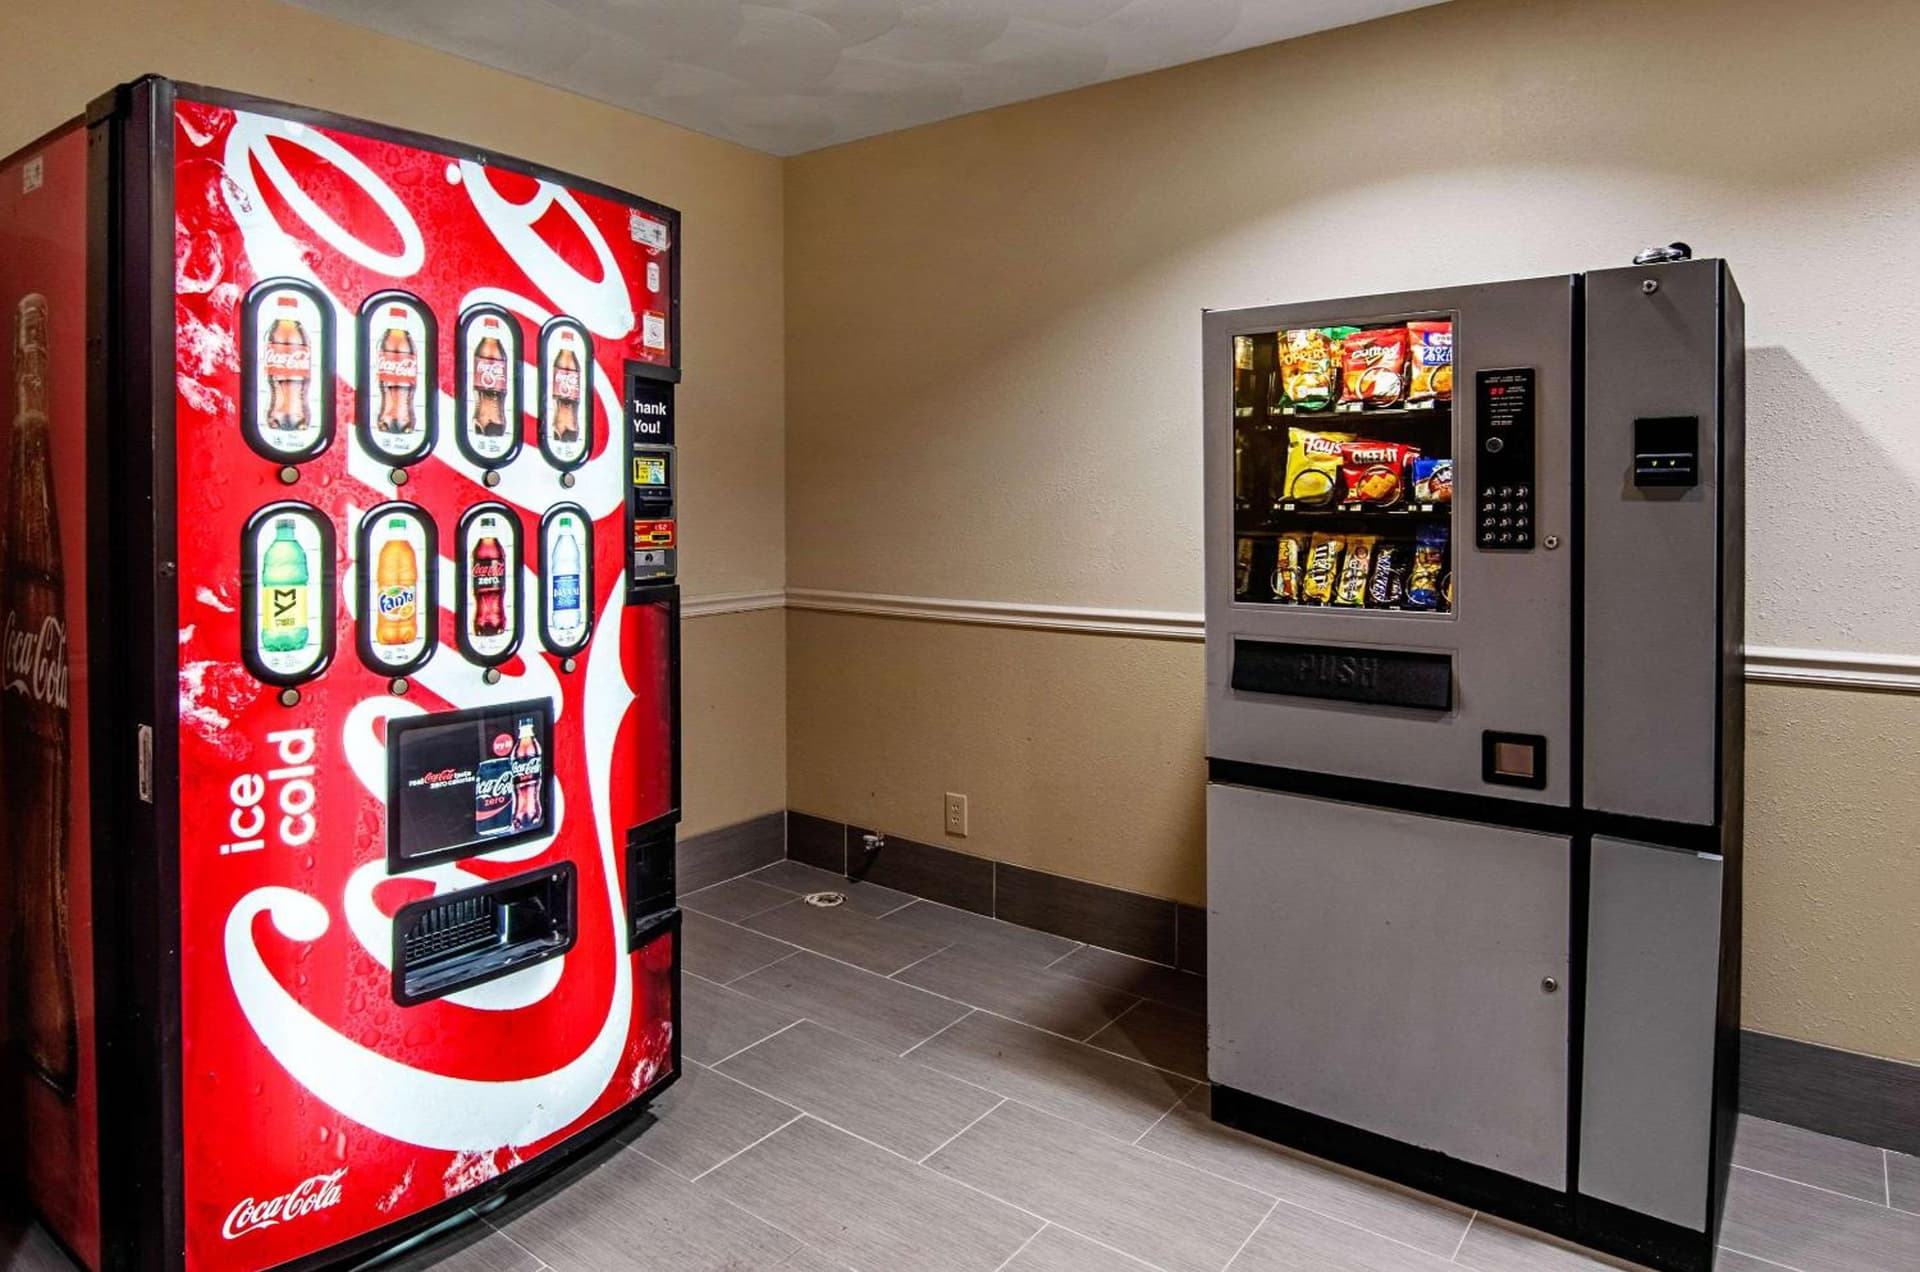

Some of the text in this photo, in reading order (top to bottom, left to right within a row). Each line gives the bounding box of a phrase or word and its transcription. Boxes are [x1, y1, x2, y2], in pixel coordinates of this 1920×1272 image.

[633, 419, 661, 434] You!
[3, 610, 68, 709] Coca-Cola
[1299, 653, 1378, 686] PUSH
[219, 773, 265, 855] ice
[267, 728, 316, 847] cold
[485, 796, 505, 806] zero
[222, 1166, 349, 1240] Coca-Cola
